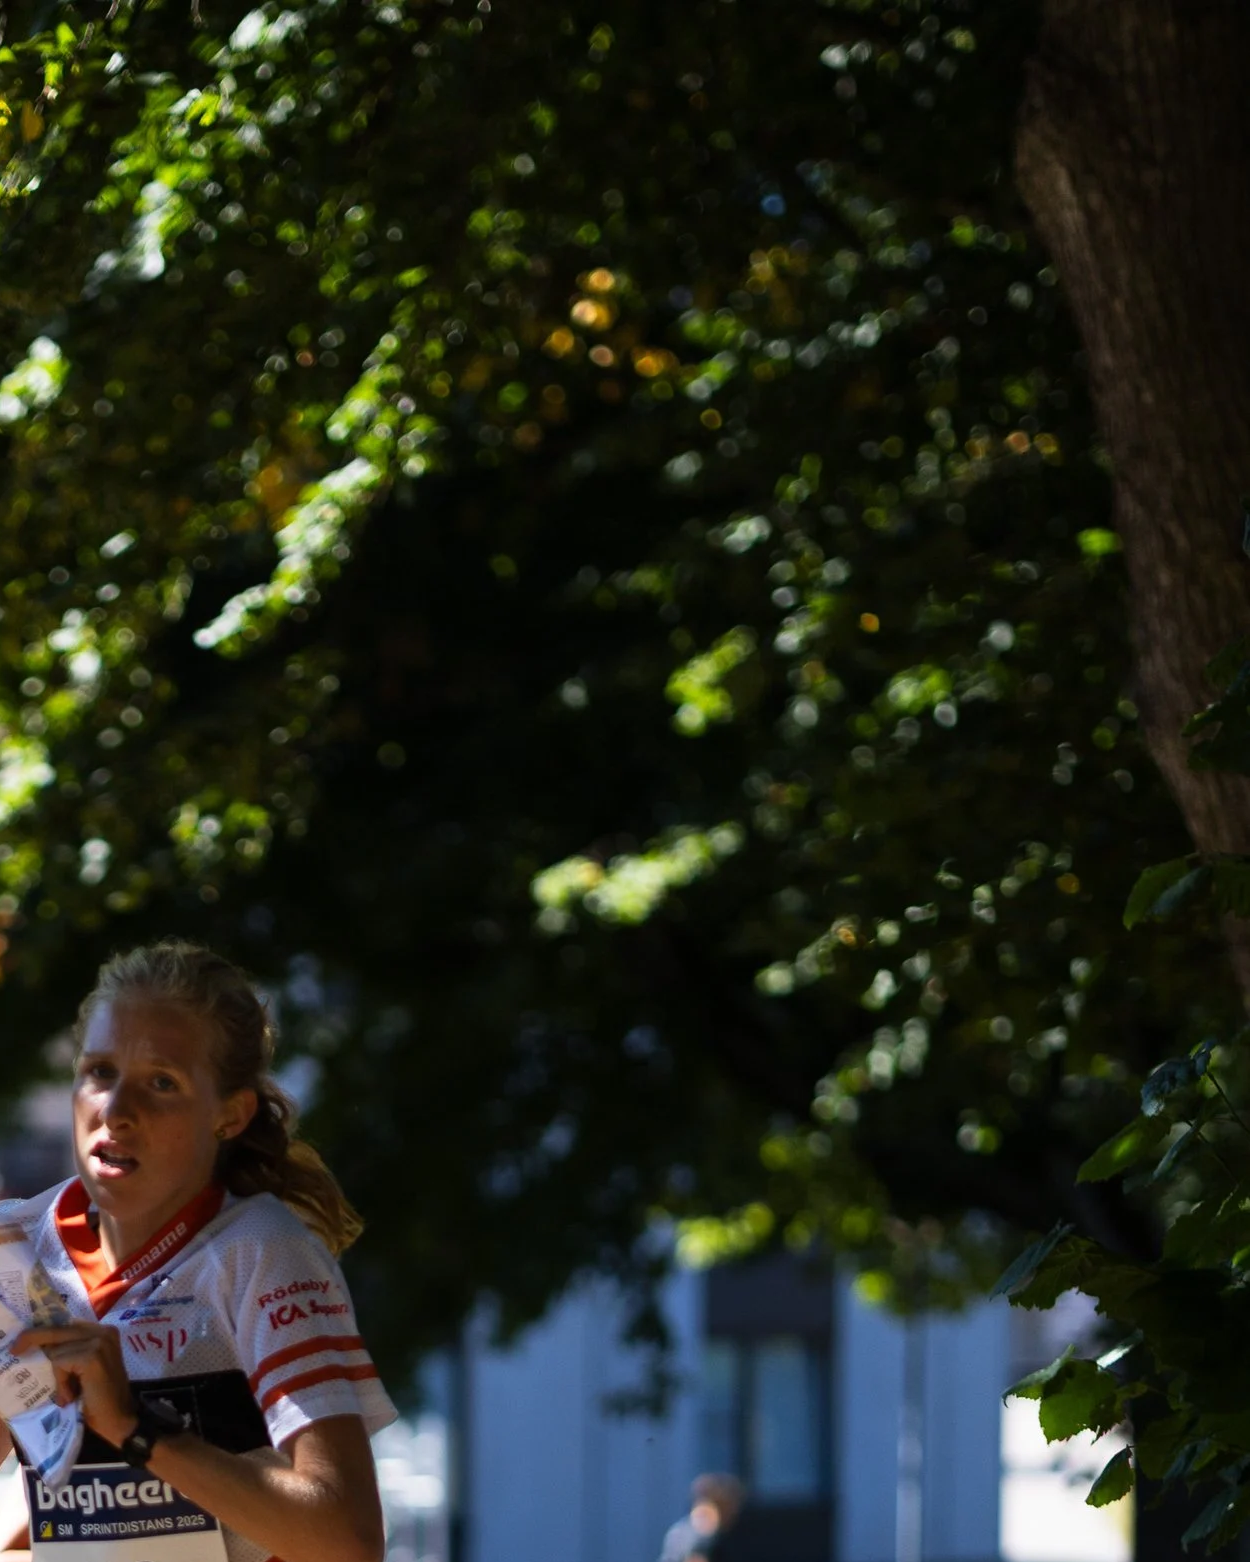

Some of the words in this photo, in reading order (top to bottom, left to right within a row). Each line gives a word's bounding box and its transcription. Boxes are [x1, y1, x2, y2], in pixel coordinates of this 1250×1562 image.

[121, 1221, 187, 1280] noname
[258, 1279, 330, 1308] Rödeby
[268, 1303, 309, 1330] ICA
[127, 1328, 187, 1362] wsp
[36, 1478, 190, 1516] bagheer
[57, 1524, 73, 1536] SM
[81, 1517, 174, 1536] SPRINTDISTANS
[177, 1514, 206, 1528] 2025
